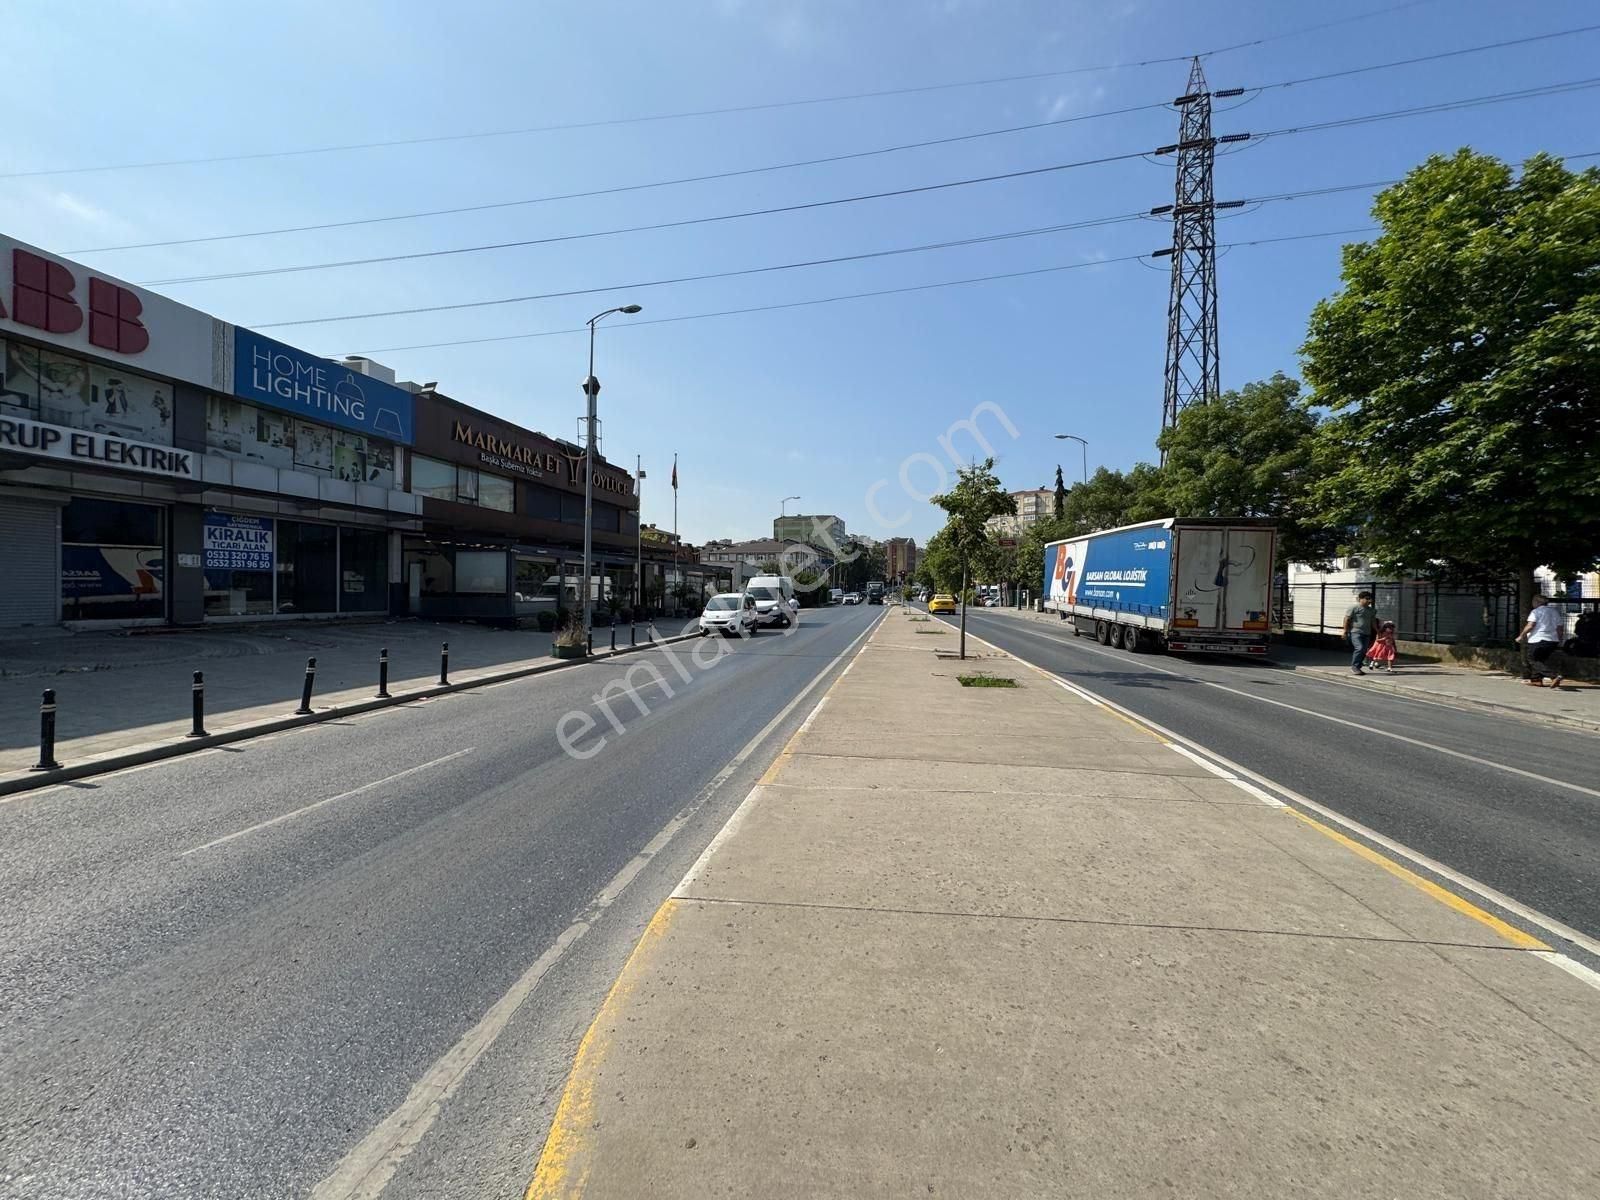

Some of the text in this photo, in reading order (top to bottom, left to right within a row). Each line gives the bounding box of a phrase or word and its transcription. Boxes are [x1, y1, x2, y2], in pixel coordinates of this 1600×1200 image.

[0, 248, 150, 355] BB
[254, 345, 327, 390] HOME
[253, 368, 365, 420] LIGHTING
[455, 420, 542, 468] MARMARA
[546, 454, 562, 474] ET
[206, 550, 230, 559] 0533
[231, 552, 248, 560] 320
[243, 543, 266, 551] ALAN
[206, 559, 230, 567] 0532
[259, 561, 270, 569] 50
[1103, 570, 1123, 581] GLOBAL
